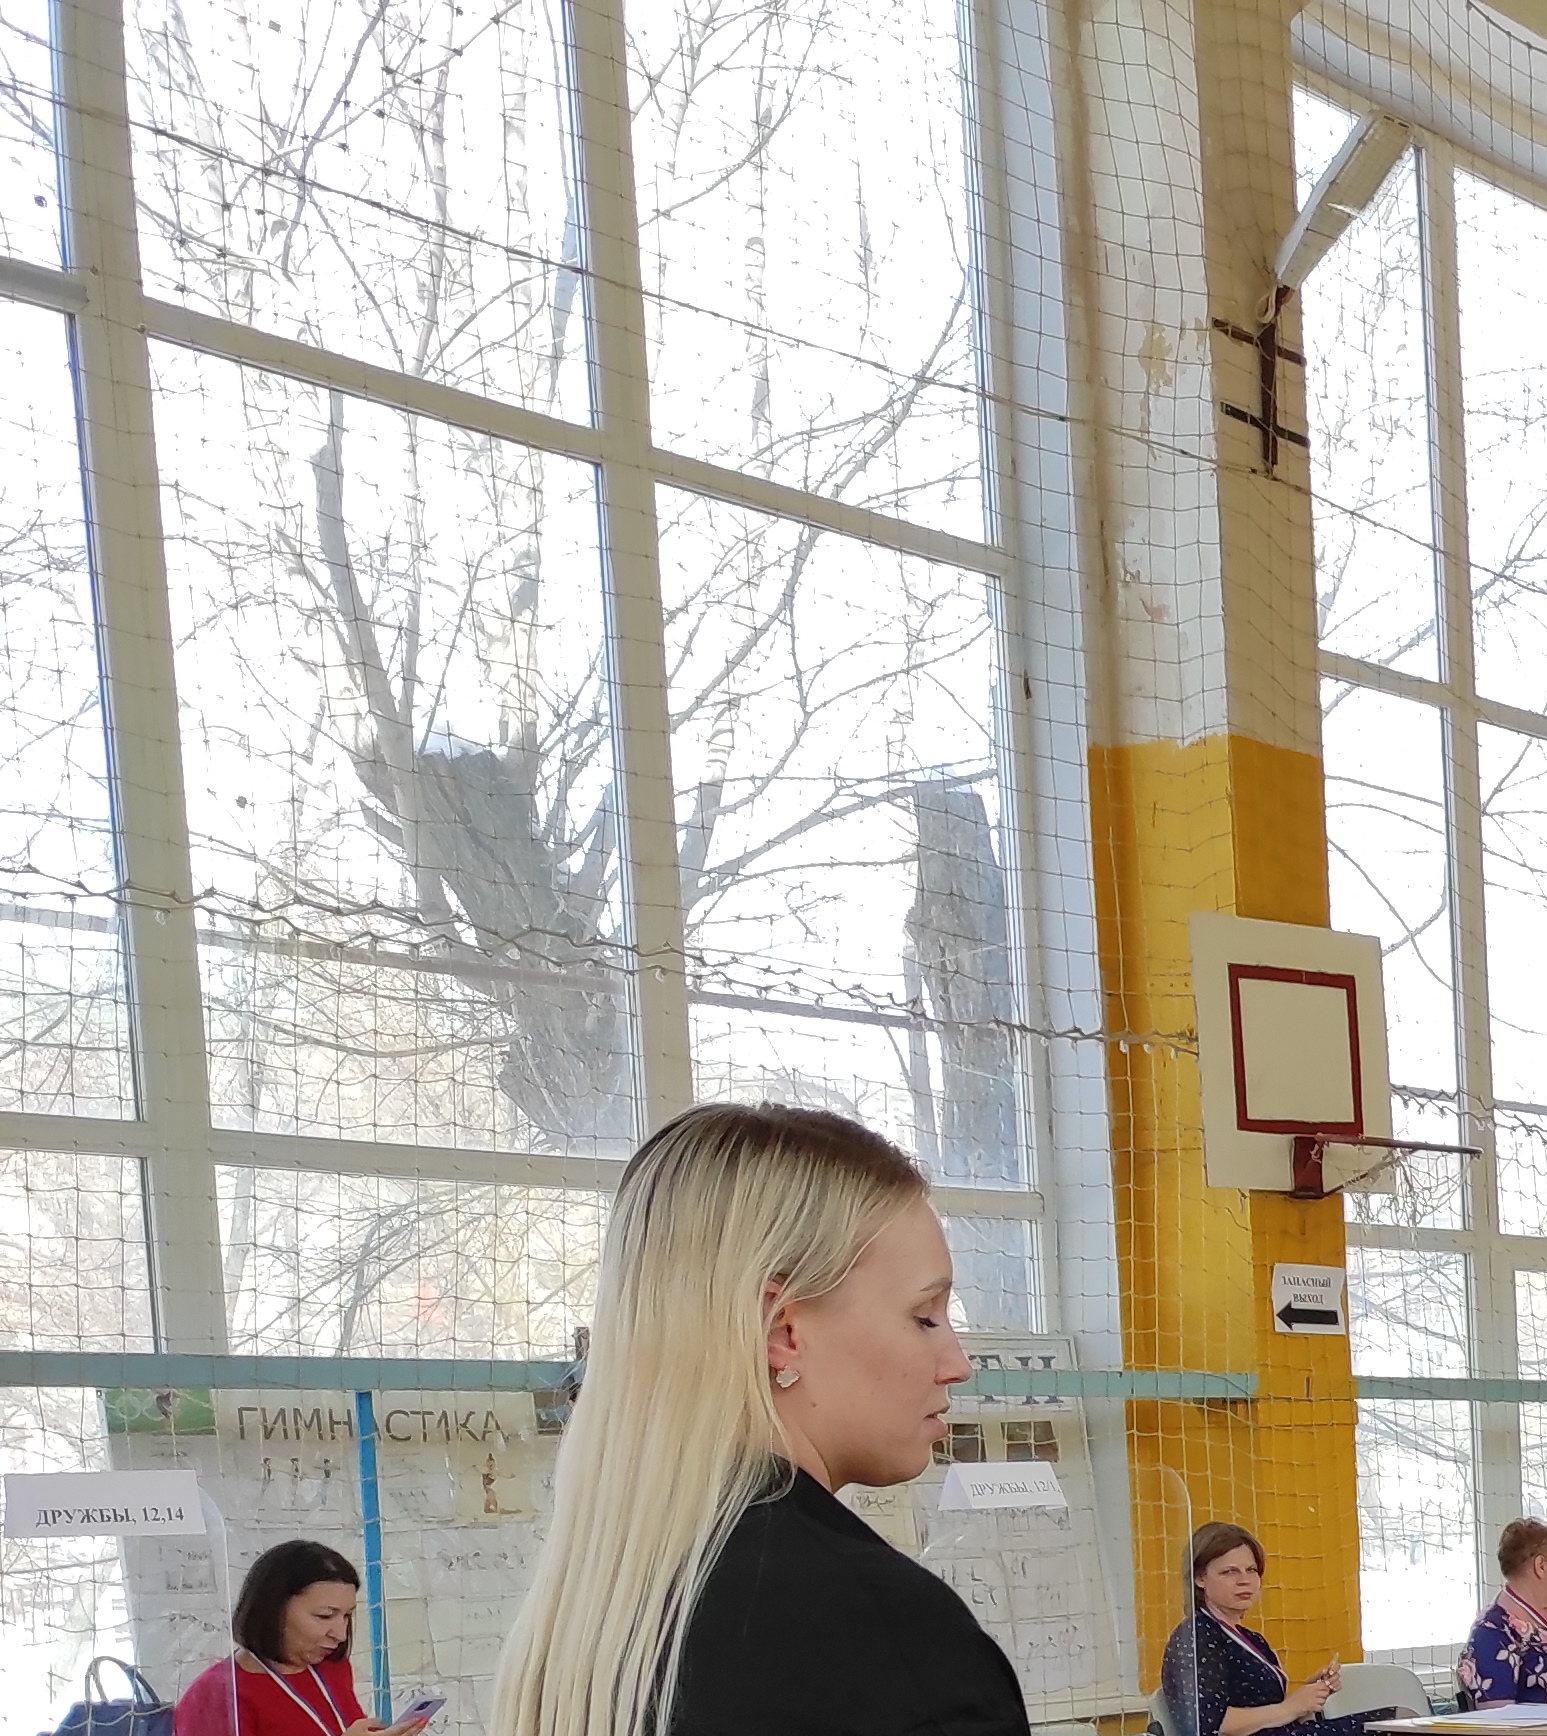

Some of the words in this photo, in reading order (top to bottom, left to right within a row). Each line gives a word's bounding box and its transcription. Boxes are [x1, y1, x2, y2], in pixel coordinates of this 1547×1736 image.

[1281, 1275, 1332, 1288] ЗАПАСНЫЙ
[1292, 1292, 1324, 1305] ВЫХОД
[35, 1508, 138, 1528] ДРУЖБЫ,
[141, 1506, 185, 1523] 12,14
